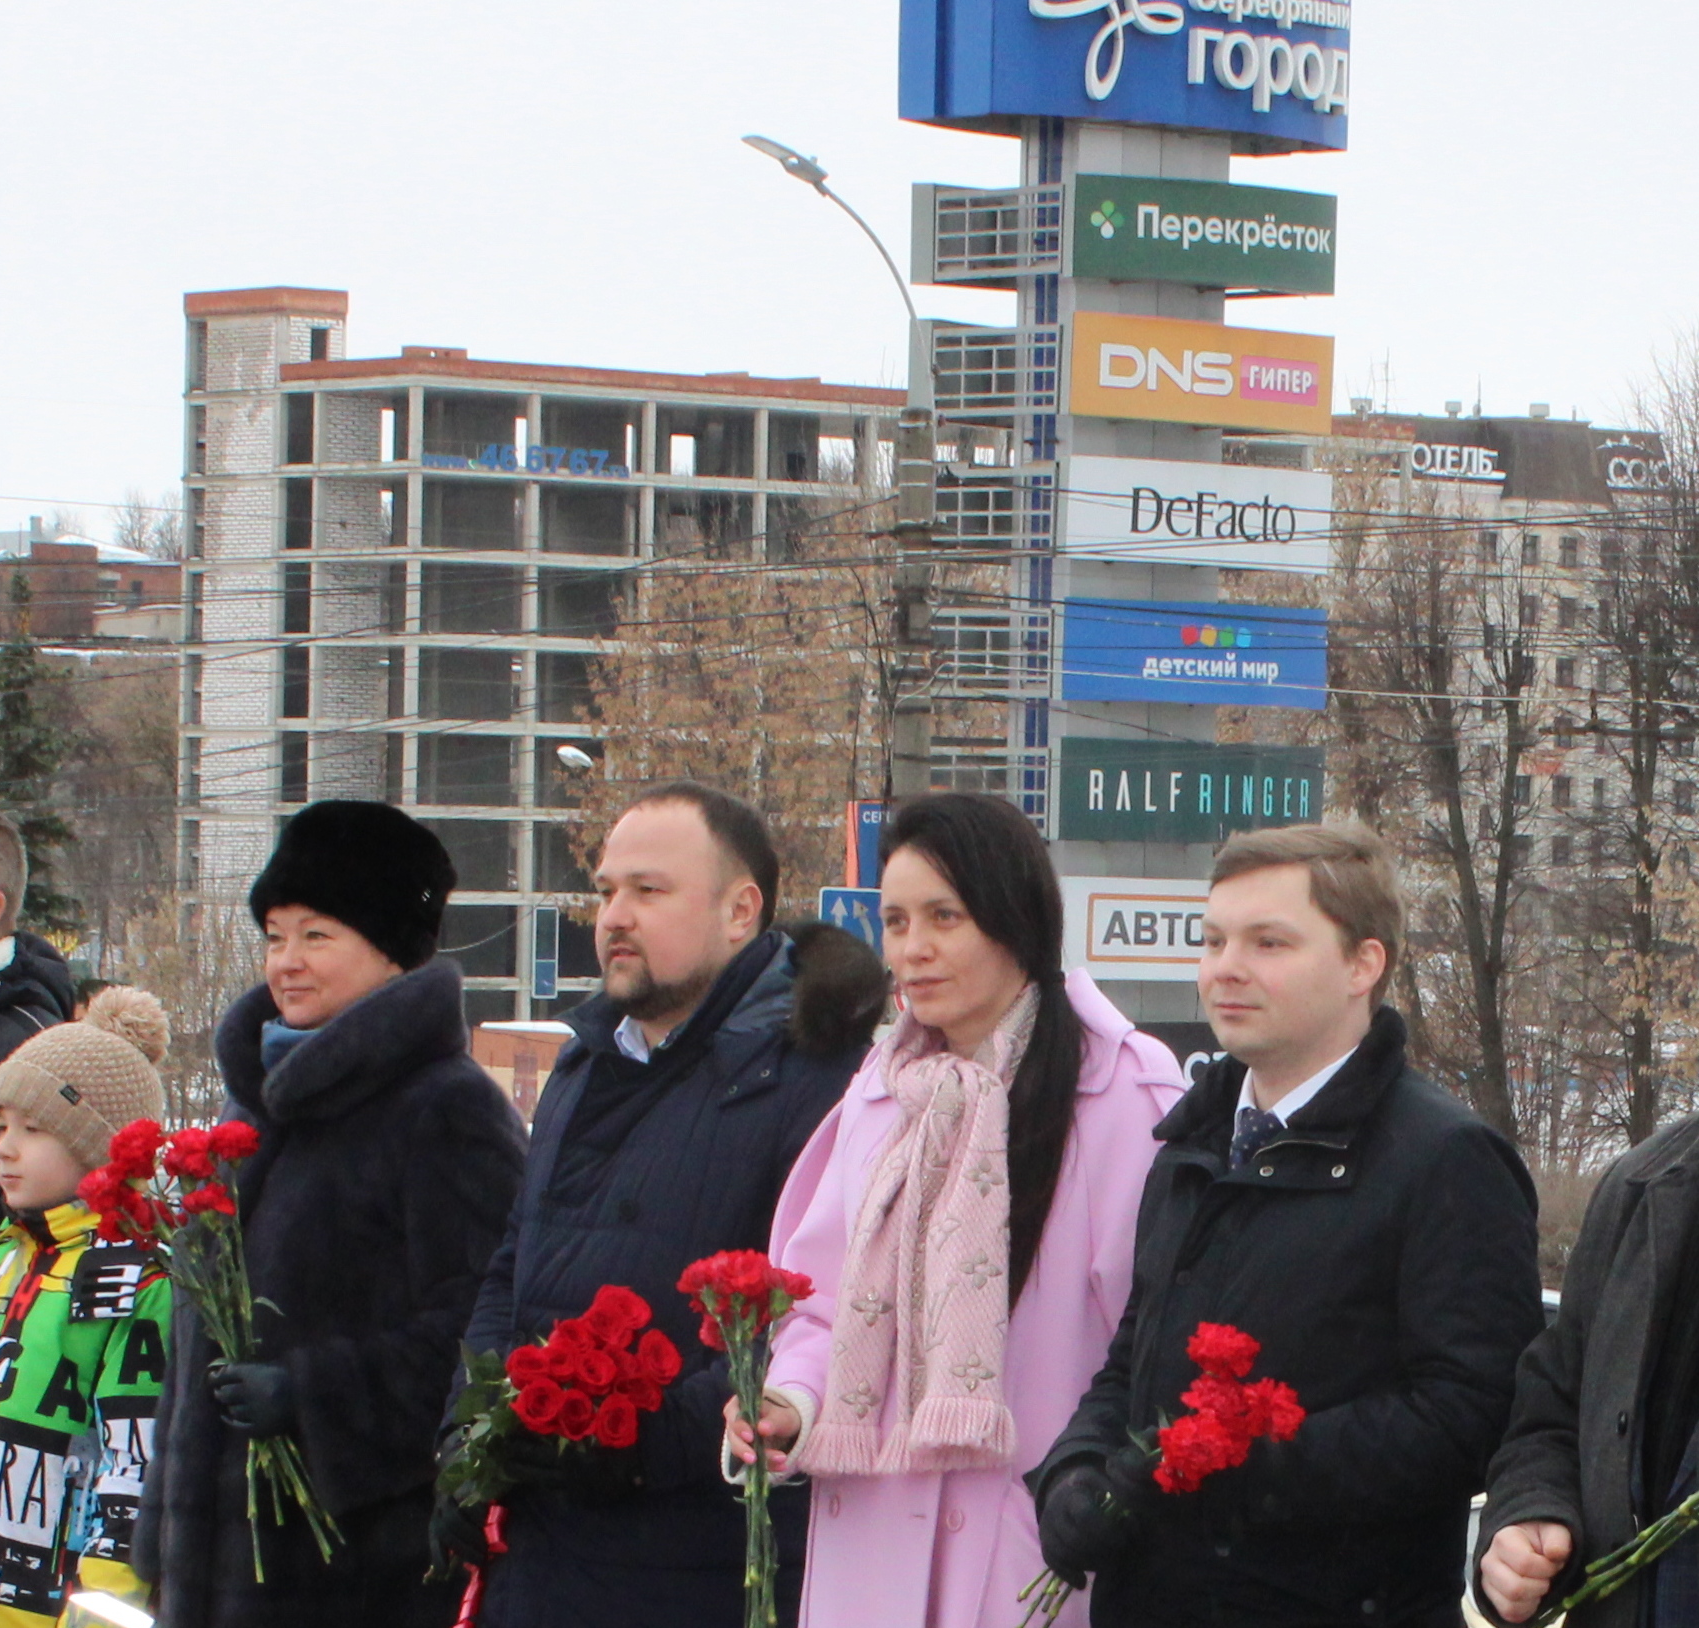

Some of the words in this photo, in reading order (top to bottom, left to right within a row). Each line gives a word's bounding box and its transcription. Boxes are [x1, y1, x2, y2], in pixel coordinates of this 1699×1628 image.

[1187, 28, 1348, 115] город
[1137, 203, 1331, 254] Перекрёсток
[1099, 343, 1234, 397] DNS
[1249, 365, 1313, 394] ГИПЕР
[1130, 486, 1296, 543] DeFacto
[1143, 652, 1236, 678] детский
[1242, 661, 1279, 685] мир
[1089, 769, 1183, 812] RALF
[1199, 773, 1309, 818] RINGER
